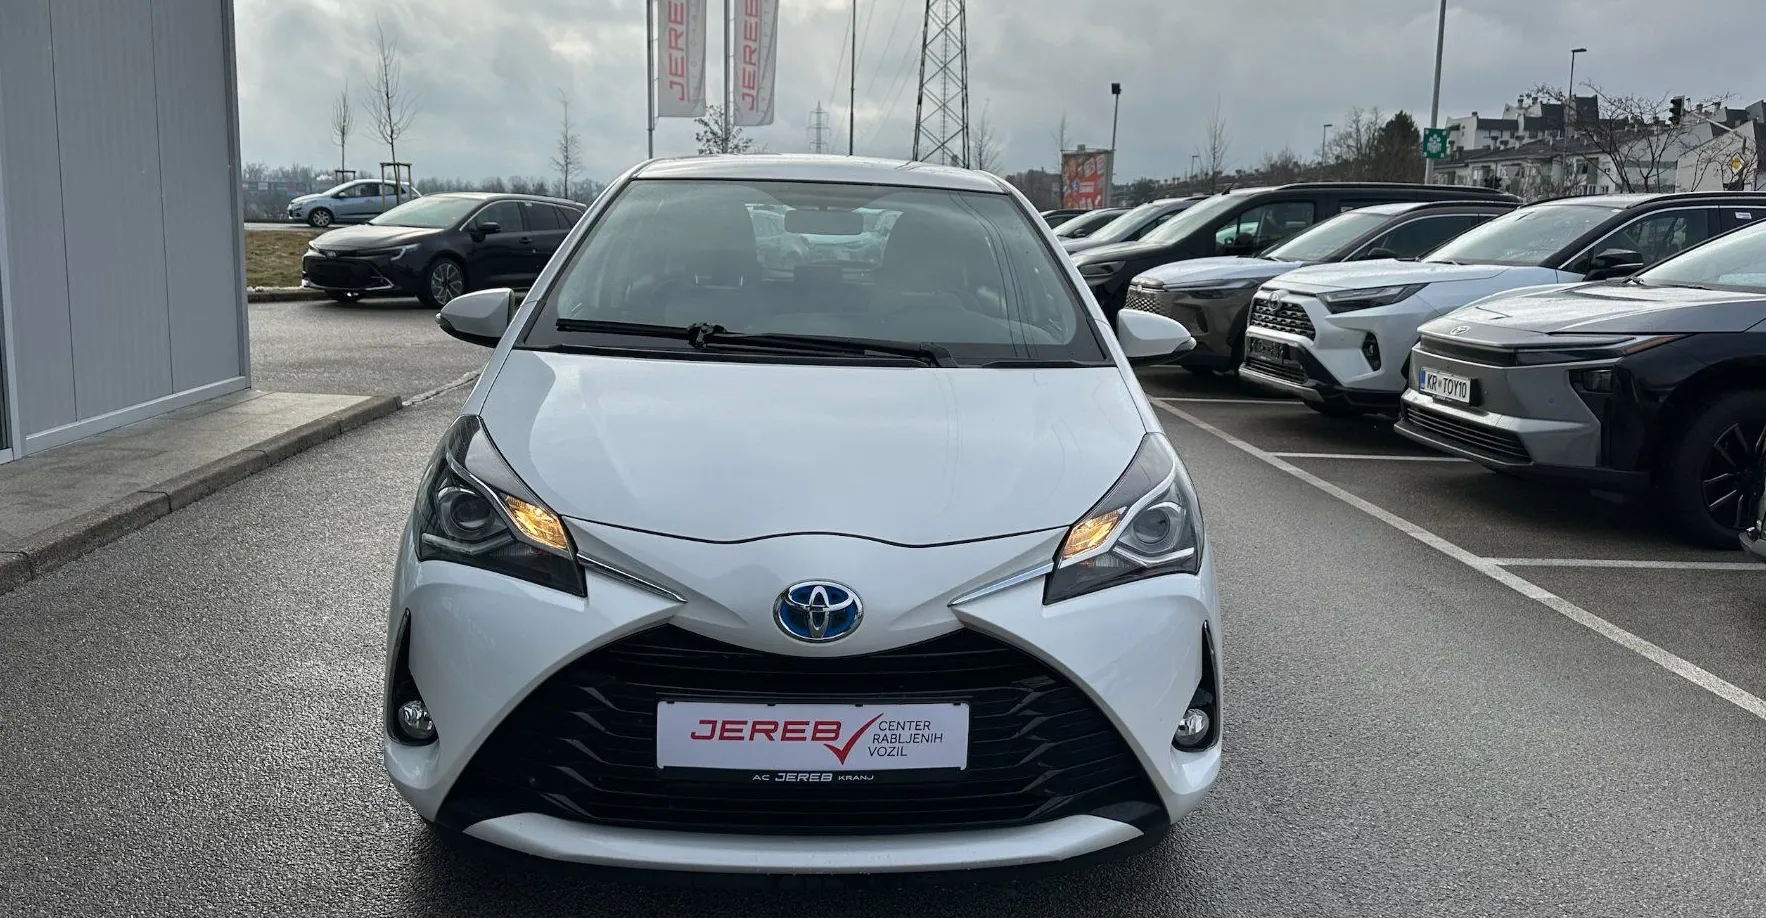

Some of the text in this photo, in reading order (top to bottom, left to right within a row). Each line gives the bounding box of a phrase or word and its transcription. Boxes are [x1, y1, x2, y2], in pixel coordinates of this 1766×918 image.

[1427, 374, 1437, 391] KR
[1443, 378, 1466, 398] TOY10
[690, 719, 842, 742] JEREB
[878, 720, 932, 732] CENTER
[872, 732, 943, 744] RABLJENIH
[868, 746, 908, 757] VOZIL
[774, 772, 833, 782] JEREB
